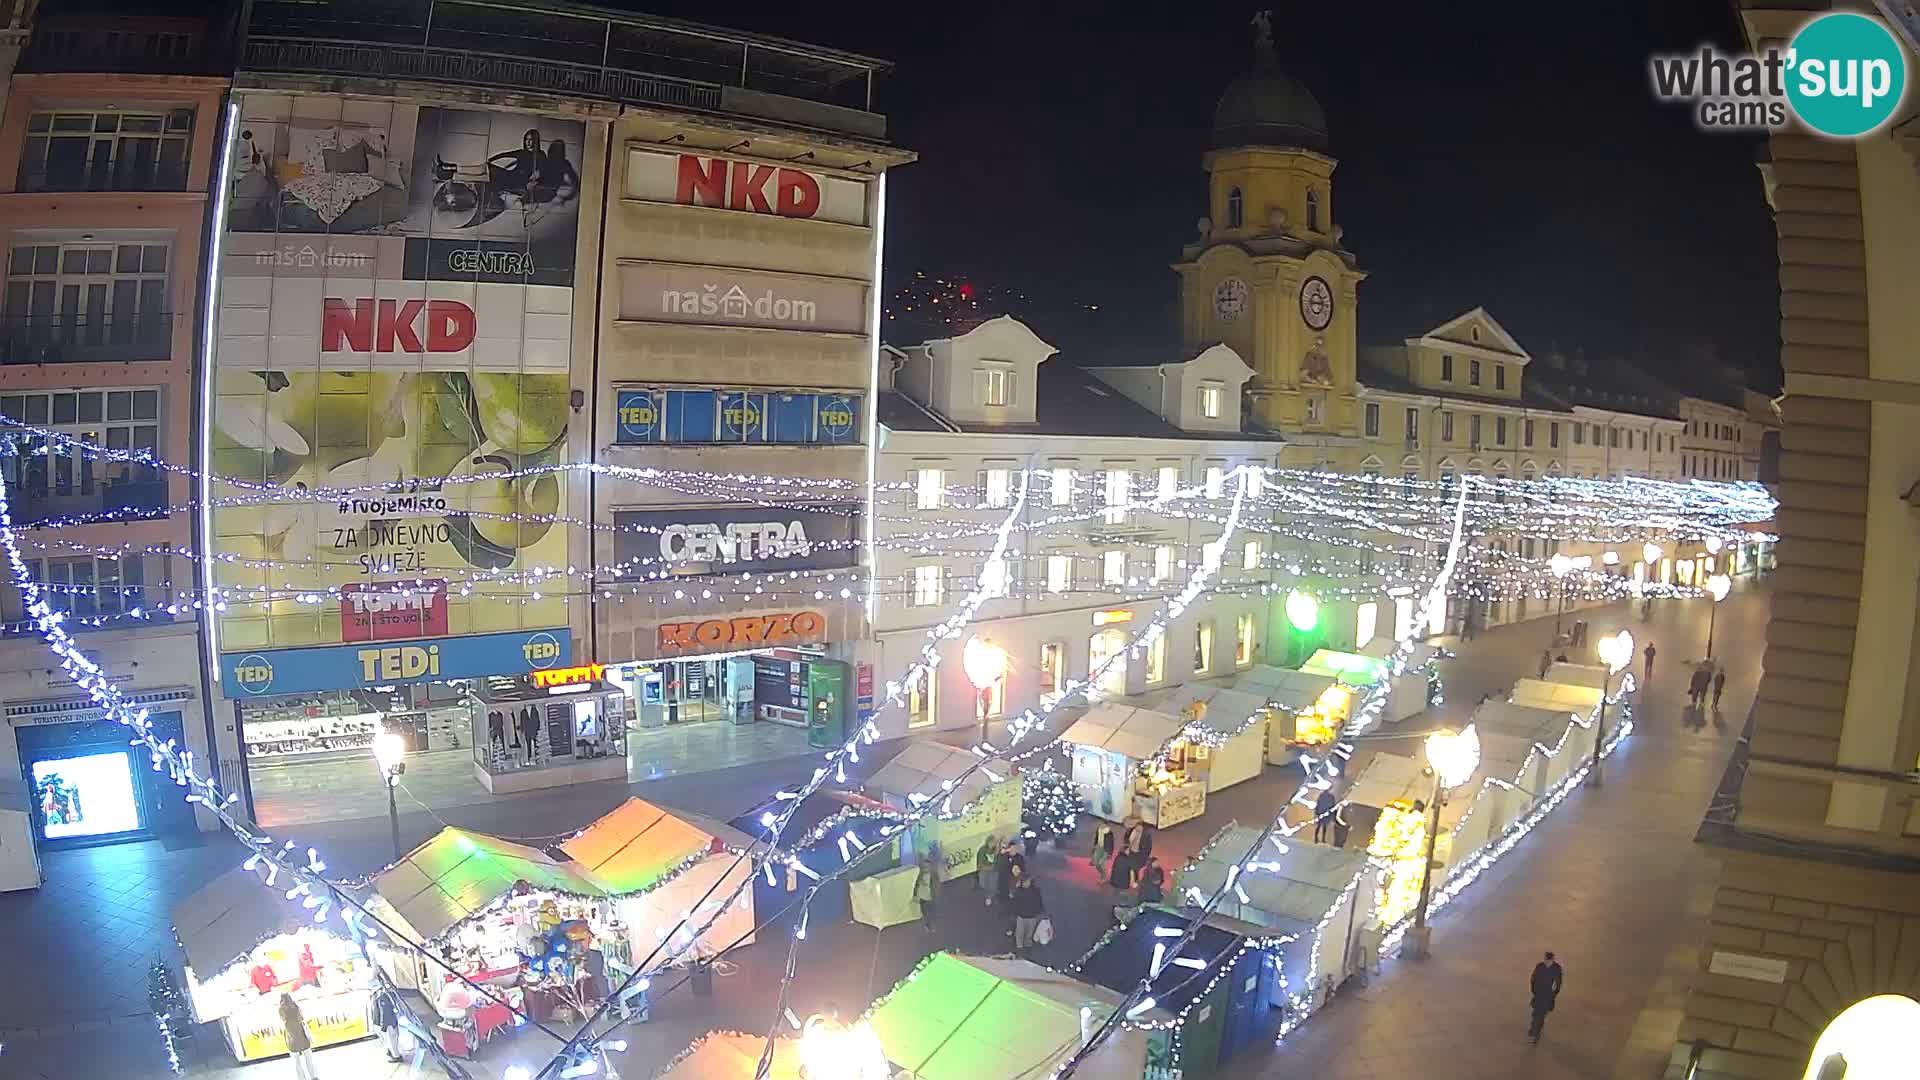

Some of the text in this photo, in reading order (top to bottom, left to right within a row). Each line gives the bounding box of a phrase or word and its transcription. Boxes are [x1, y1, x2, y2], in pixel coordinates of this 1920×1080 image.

[675, 153, 820, 218] NKD
[255, 245, 369, 268] naš dom
[448, 249, 535, 275] CENTRA
[661, 283, 816, 321] naš dom
[321, 297, 478, 353] NKD
[618, 407, 658, 425] TEDi
[723, 408, 760, 425] TEDi
[338, 496, 446, 516] #TvojeMisto
[334, 523, 450, 548] ZA DNEVNO
[659, 520, 810, 562] CENTRA
[659, 611, 827, 650] KORZO
[358, 644, 441, 682] TEDi
[522, 641, 561, 661] TEDi
[234, 664, 273, 684] TEDi
